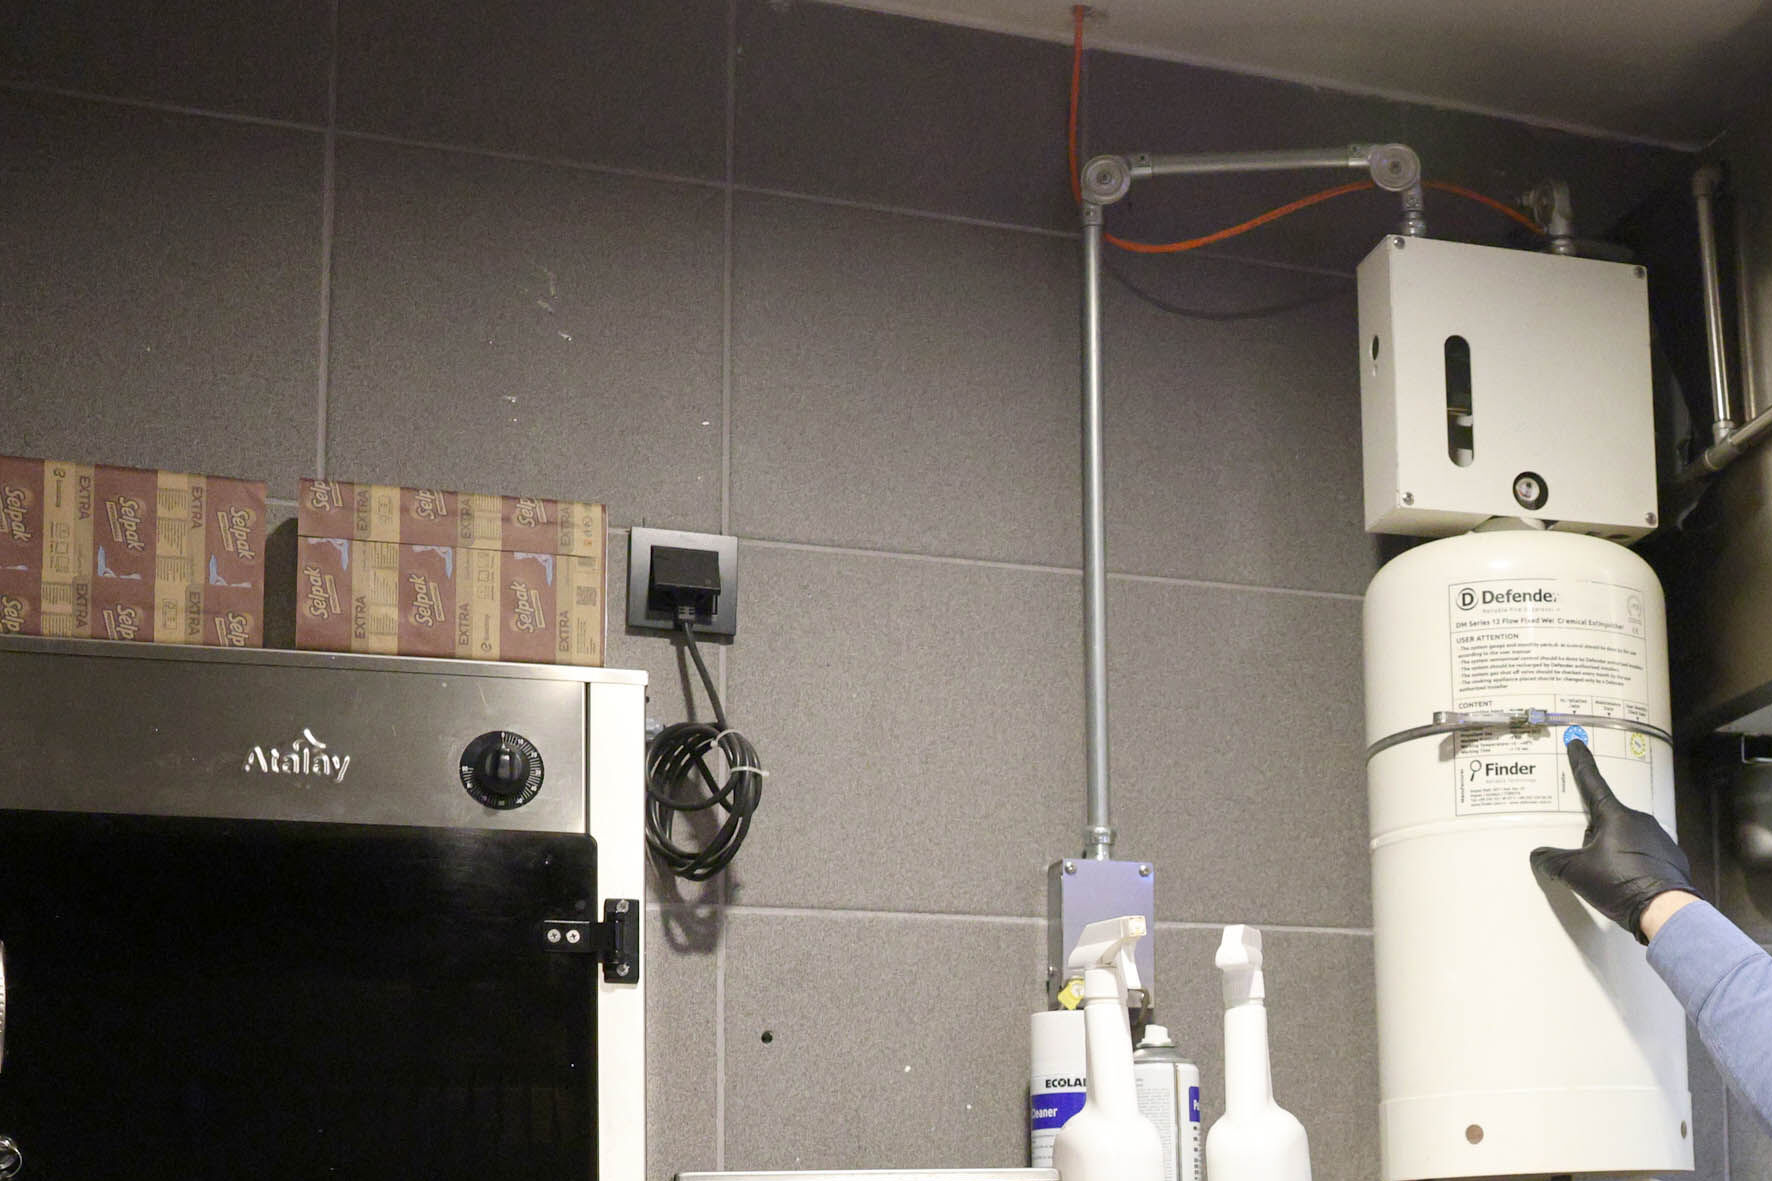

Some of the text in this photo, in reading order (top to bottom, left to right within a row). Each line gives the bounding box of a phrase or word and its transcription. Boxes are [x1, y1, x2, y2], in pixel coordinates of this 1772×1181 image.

[4, 486, 32, 542] Selpak
[79, 475, 91, 521] EXTRA
[191, 485, 203, 529] EXTRA
[356, 489, 368, 531] EXTRA
[461, 498, 472, 538] EXTRA
[119, 496, 145, 551] Selpak
[231, 506, 256, 560] Selpak
[561, 506, 572, 547] EXTRA
[76, 583, 88, 629] EXTRA
[188, 591, 200, 636] EXTRA
[304, 566, 328, 619] Selpak
[409, 574, 433, 627] Selpak
[510, 580, 534, 633] Selpak
[1482, 588, 1557, 604] Defende
[354, 595, 366, 640] EXTRA
[458, 602, 469, 647] EXTRA
[559, 610, 569, 653] EXTRA
[1476, 633, 1519, 641] ATTENTION
[1458, 700, 1493, 709] CONTENT
[243, 745, 350, 783] Atalay
[1485, 762, 1536, 777] Finder
